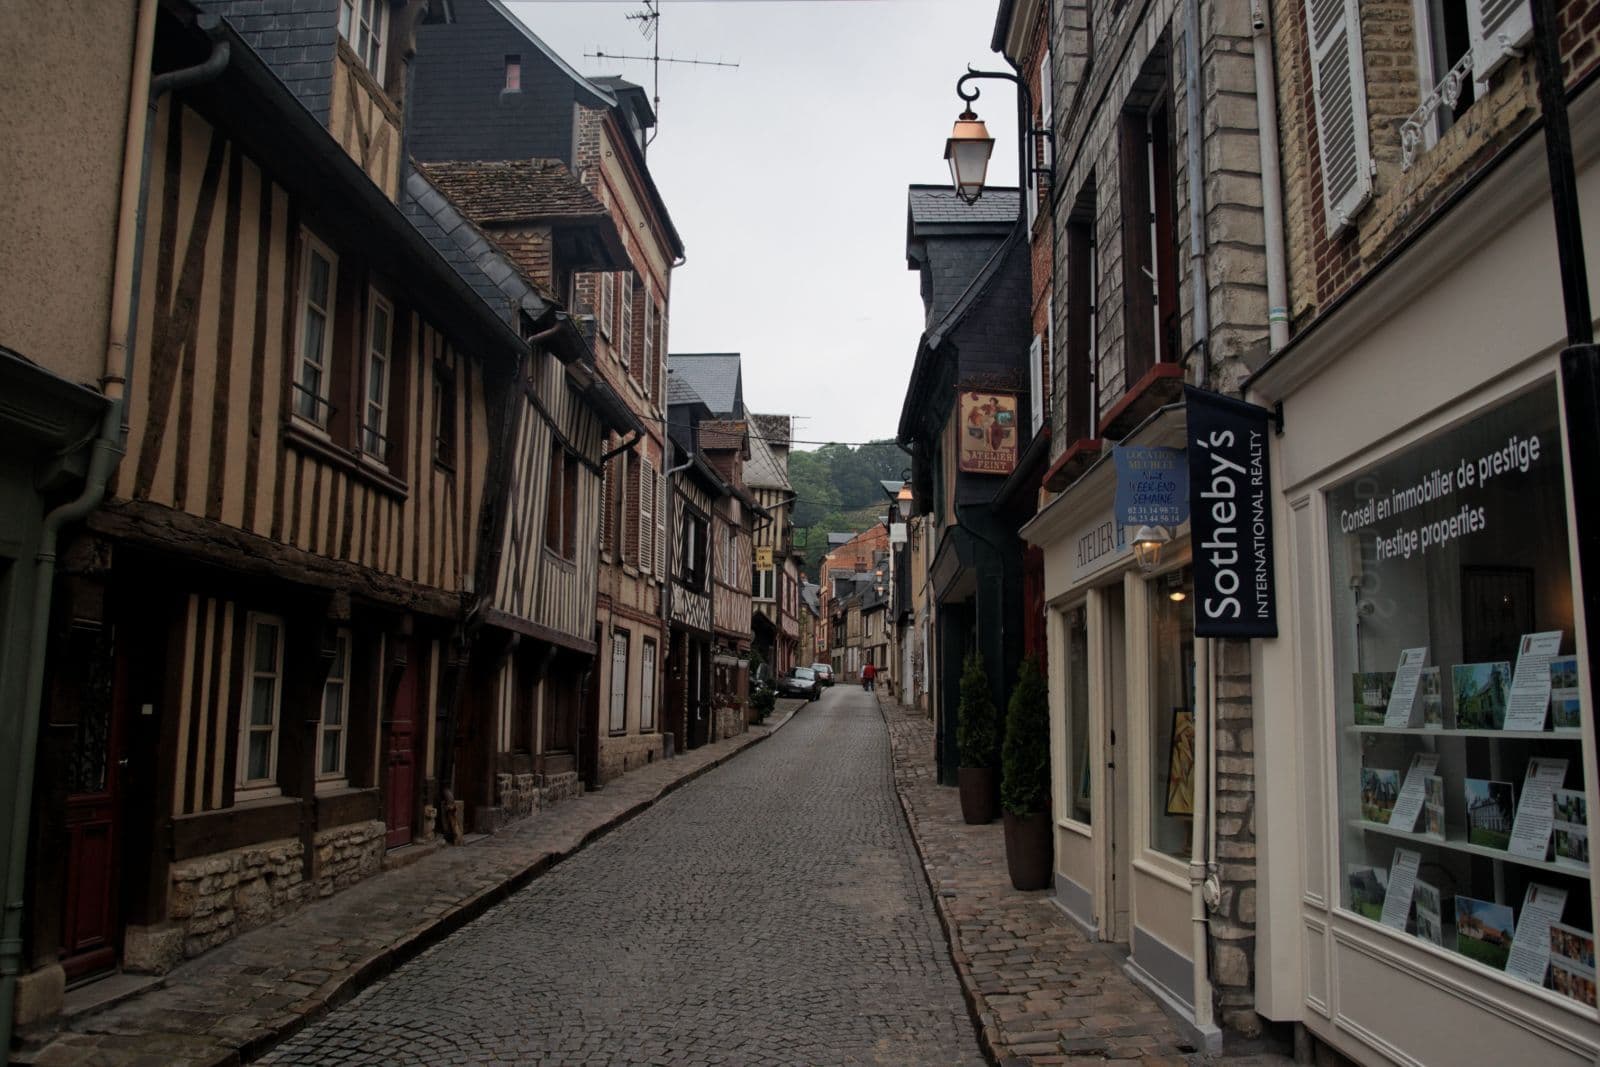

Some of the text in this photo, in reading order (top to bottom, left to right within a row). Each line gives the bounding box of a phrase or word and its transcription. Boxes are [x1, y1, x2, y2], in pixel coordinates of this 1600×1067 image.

[1197, 429, 1246, 618] Sotheby's
[1250, 430, 1269, 618] INTERNATIONAL REALTY
[1341, 435, 1541, 533] Conseil en immobilier de prestige
[1376, 505, 1486, 561] Prestige properties
[1077, 521, 1114, 568] ATELIER
